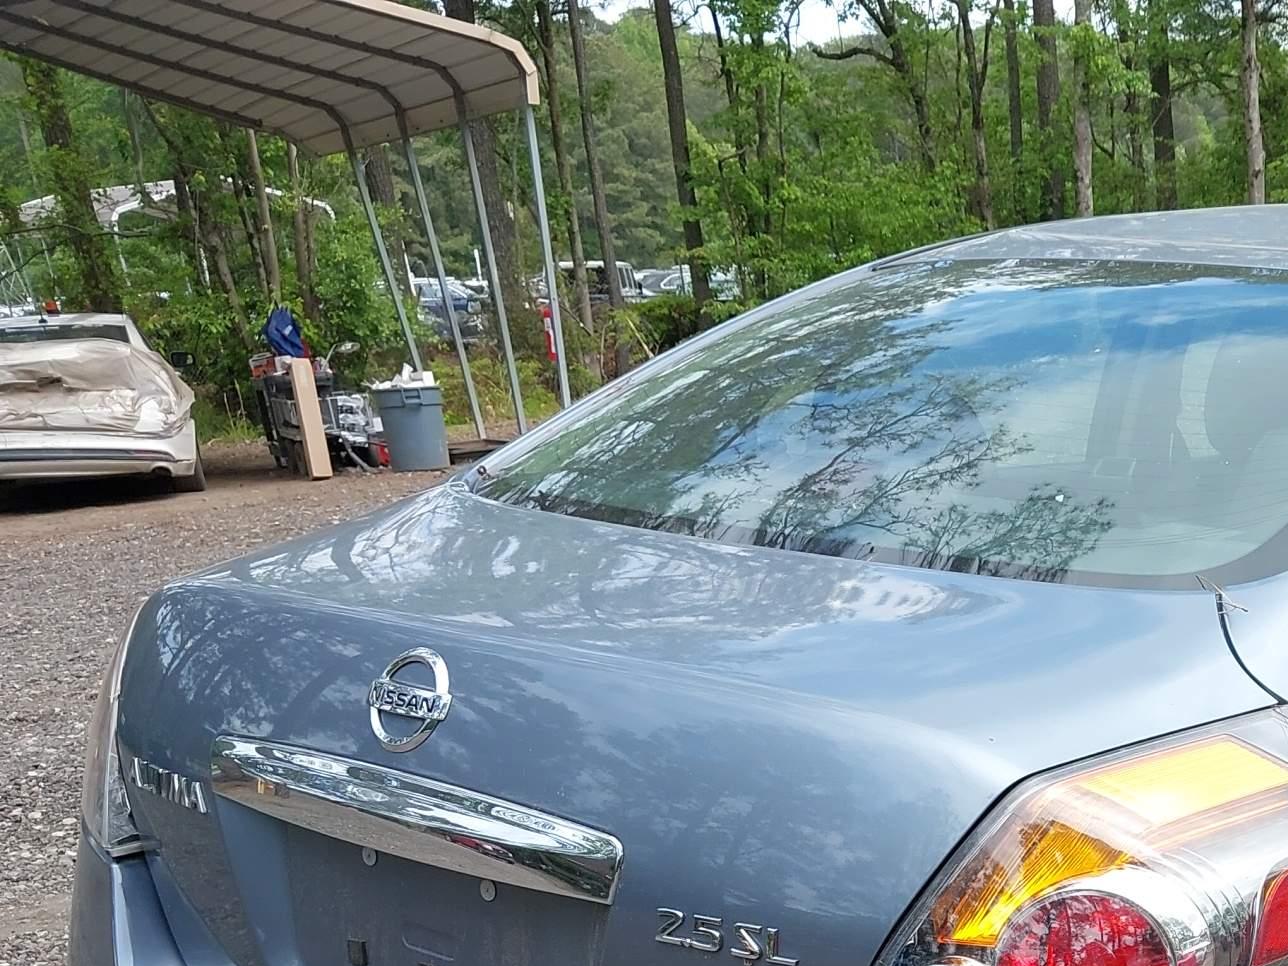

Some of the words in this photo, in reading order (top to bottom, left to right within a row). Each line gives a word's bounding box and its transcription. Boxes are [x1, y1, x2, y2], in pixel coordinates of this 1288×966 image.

[372, 685, 437, 714] NISSAN
[655, 907, 724, 953] 2.5
[730, 922, 800, 966] SL
